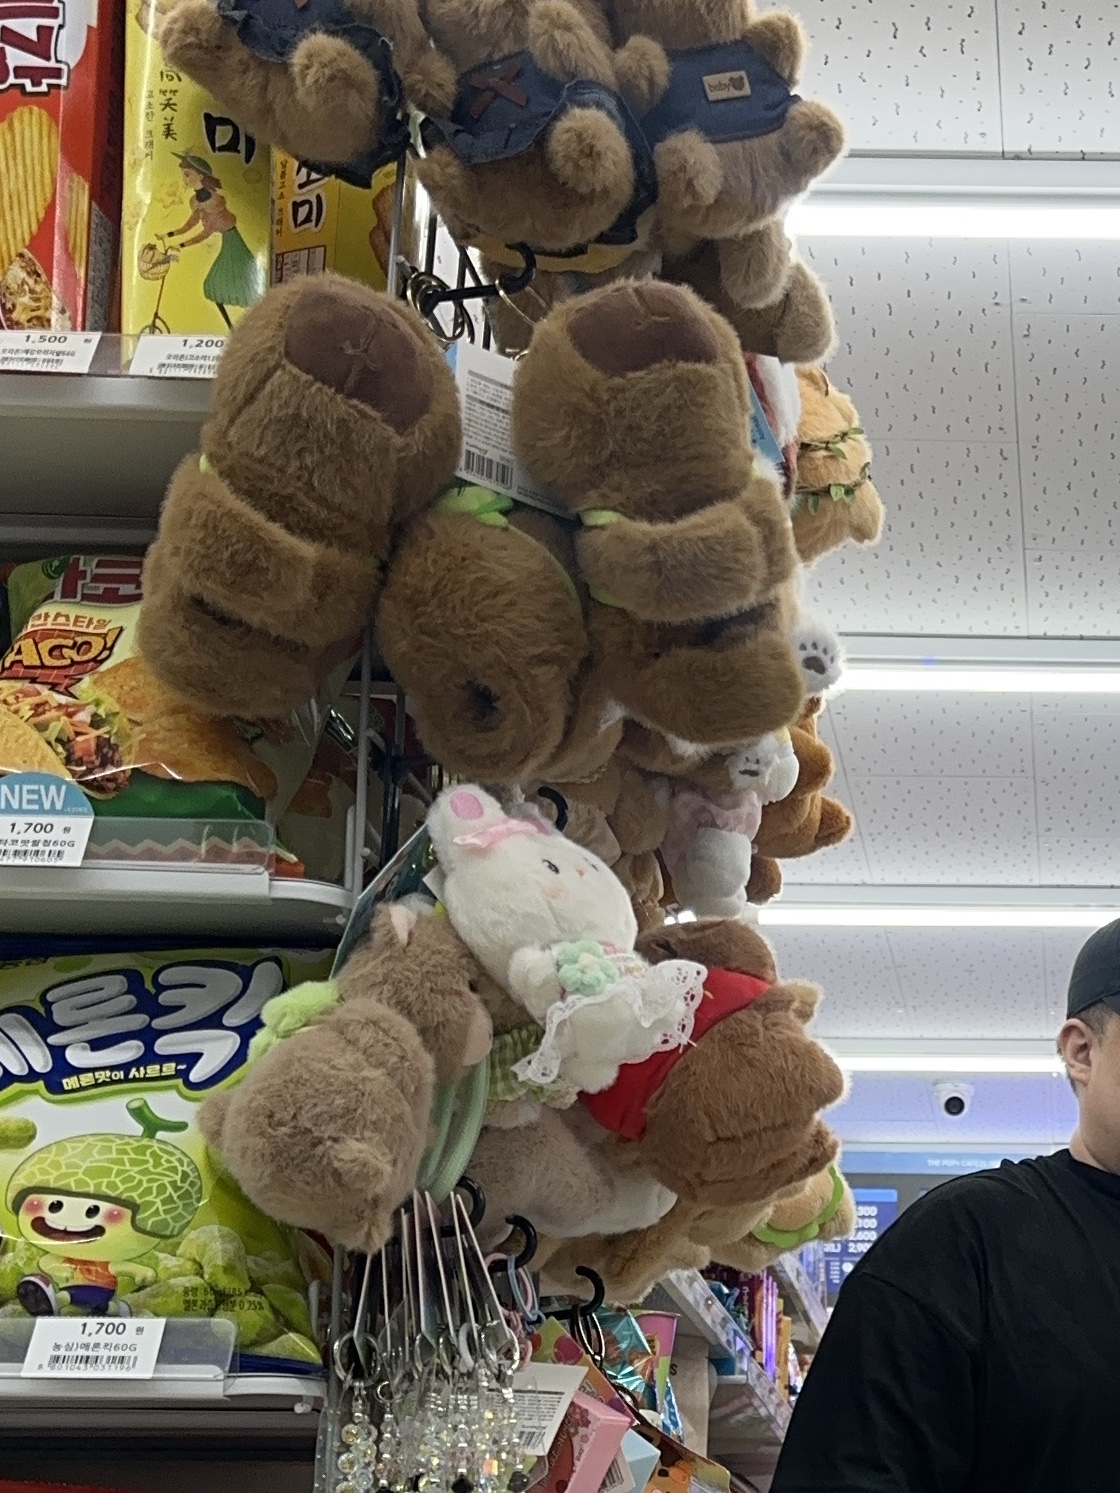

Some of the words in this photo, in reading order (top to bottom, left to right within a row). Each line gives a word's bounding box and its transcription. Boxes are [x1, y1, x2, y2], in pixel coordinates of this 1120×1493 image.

[25, 335, 67, 343] 1,500
[182, 339, 224, 348] 1,200
[0, 784, 67, 811] NEW
[10, 822, 54, 835] 1,700
[62, 1069, 125, 1091] 메론맛이
[81, 1322, 126, 1337] 1,700
[135, 1325, 145, 1335] 원
